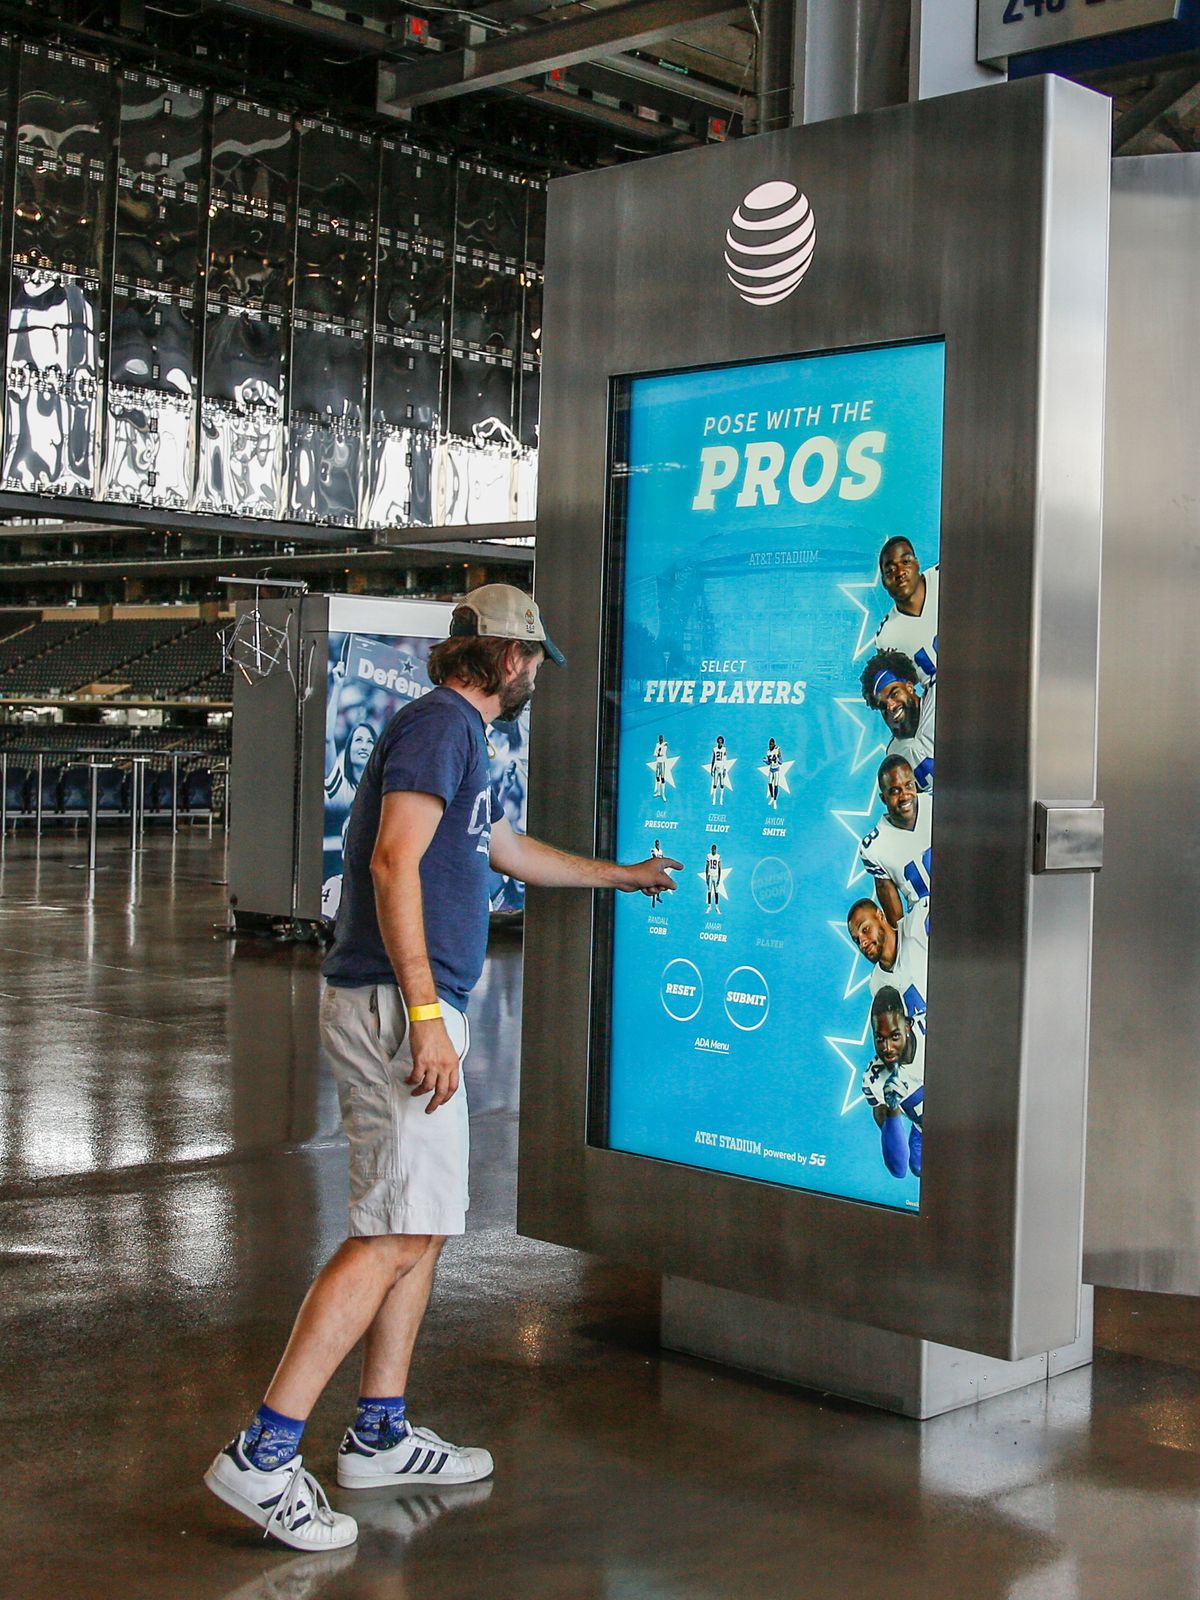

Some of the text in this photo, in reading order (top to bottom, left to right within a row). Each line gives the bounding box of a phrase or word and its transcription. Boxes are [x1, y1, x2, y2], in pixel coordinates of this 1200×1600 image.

[703, 400, 874, 436] POSE WITH THE
[692, 430, 886, 510] PROS
[748, 550, 819, 565] AT&T STADIUM
[701, 660, 747, 673] SELECT
[644, 679, 807, 705] FIVE PLAYERS
[644, 820, 679, 830] PRESCOTT
[705, 824, 730, 833] ELLIOT
[762, 828, 787, 837] SMITH
[649, 926, 668, 935] COBB
[699, 932, 728, 943] COOPER
[665, 983, 697, 997] RESET
[726, 991, 767, 1006] SUBMIT
[694, 1037, 730, 1051] ADA Menu
[694, 1130, 827, 1167] AT&T STADIUM powered by 5G
